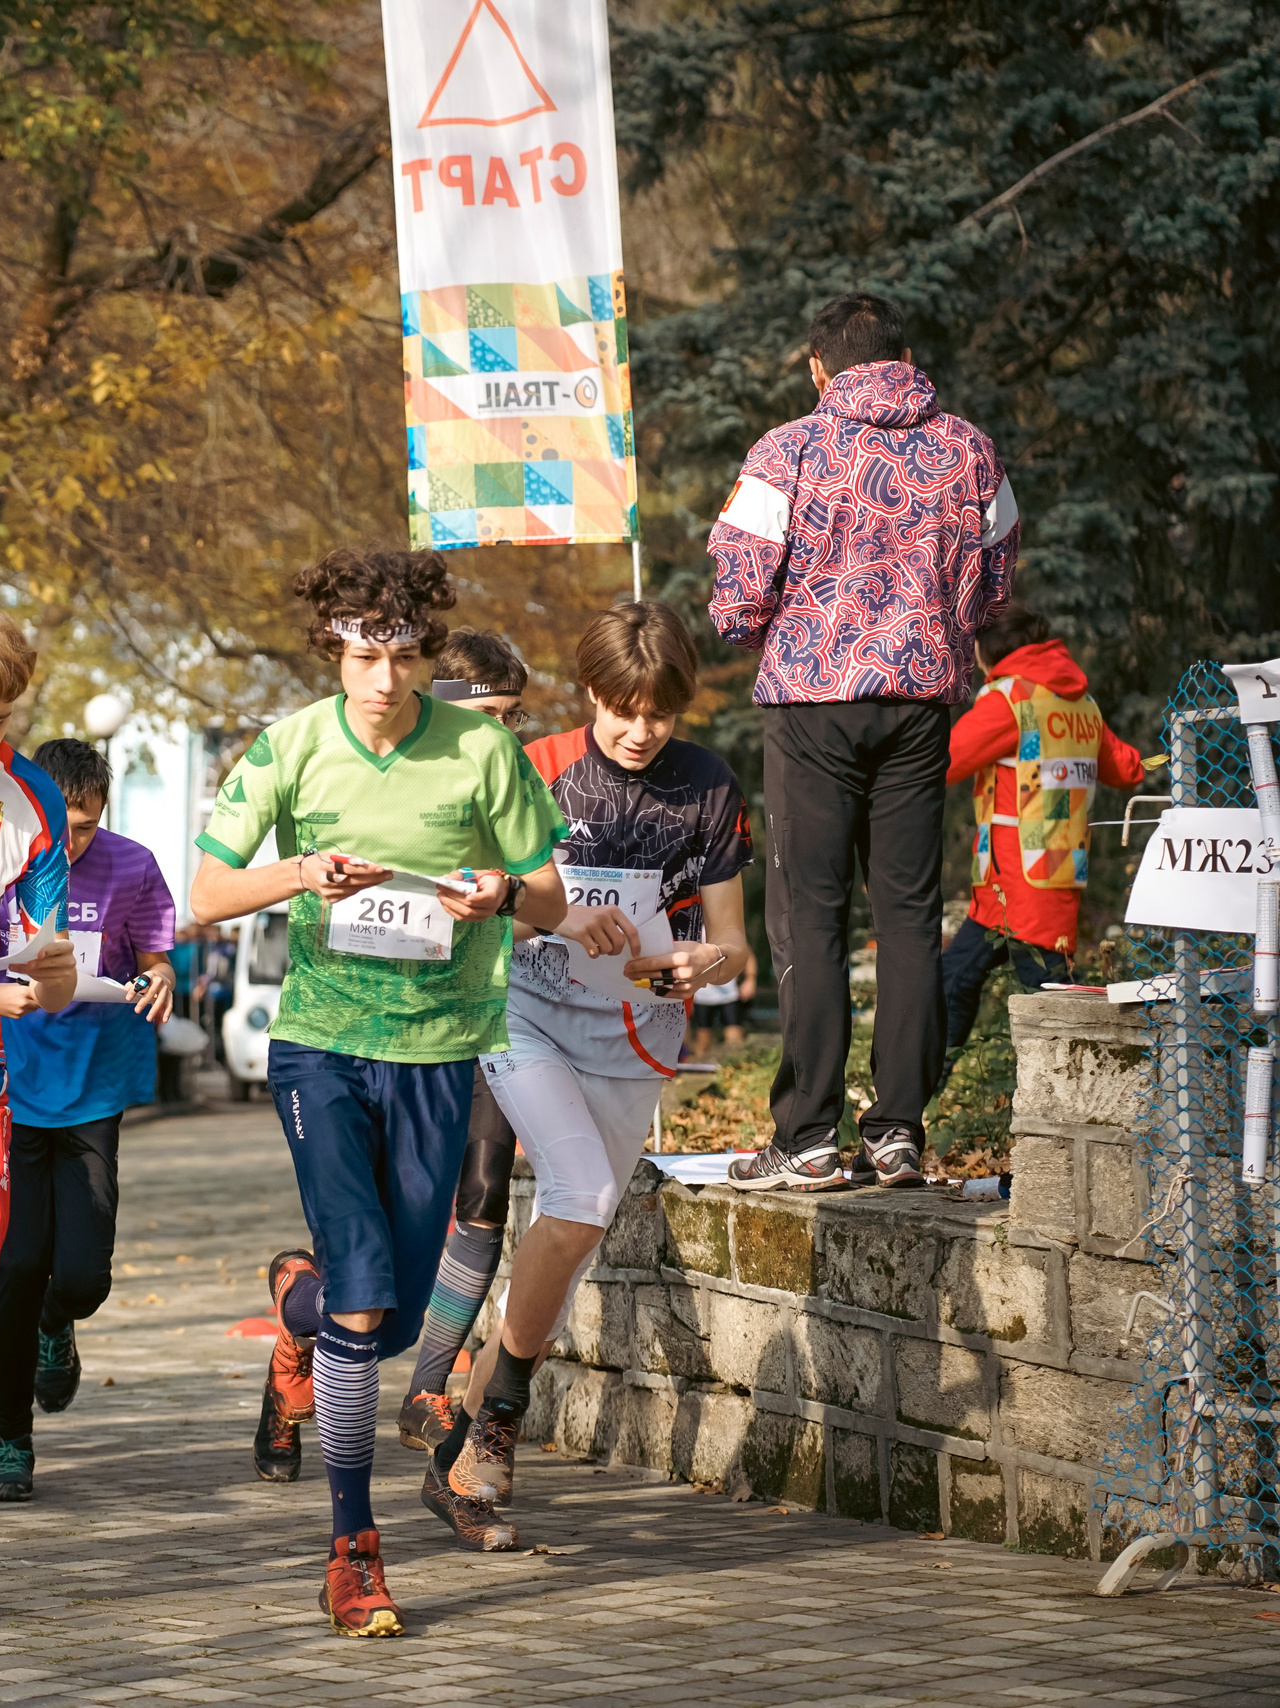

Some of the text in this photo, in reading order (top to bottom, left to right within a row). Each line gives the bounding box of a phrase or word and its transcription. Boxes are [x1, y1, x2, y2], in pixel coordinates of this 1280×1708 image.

[600, 871, 624, 879] РОССИИ
[569, 886, 638, 916] 260 1
[357, 897, 432, 930] 261 1
[349, 922, 387, 937] МЖ16
[80, 951, 86, 964] 1
